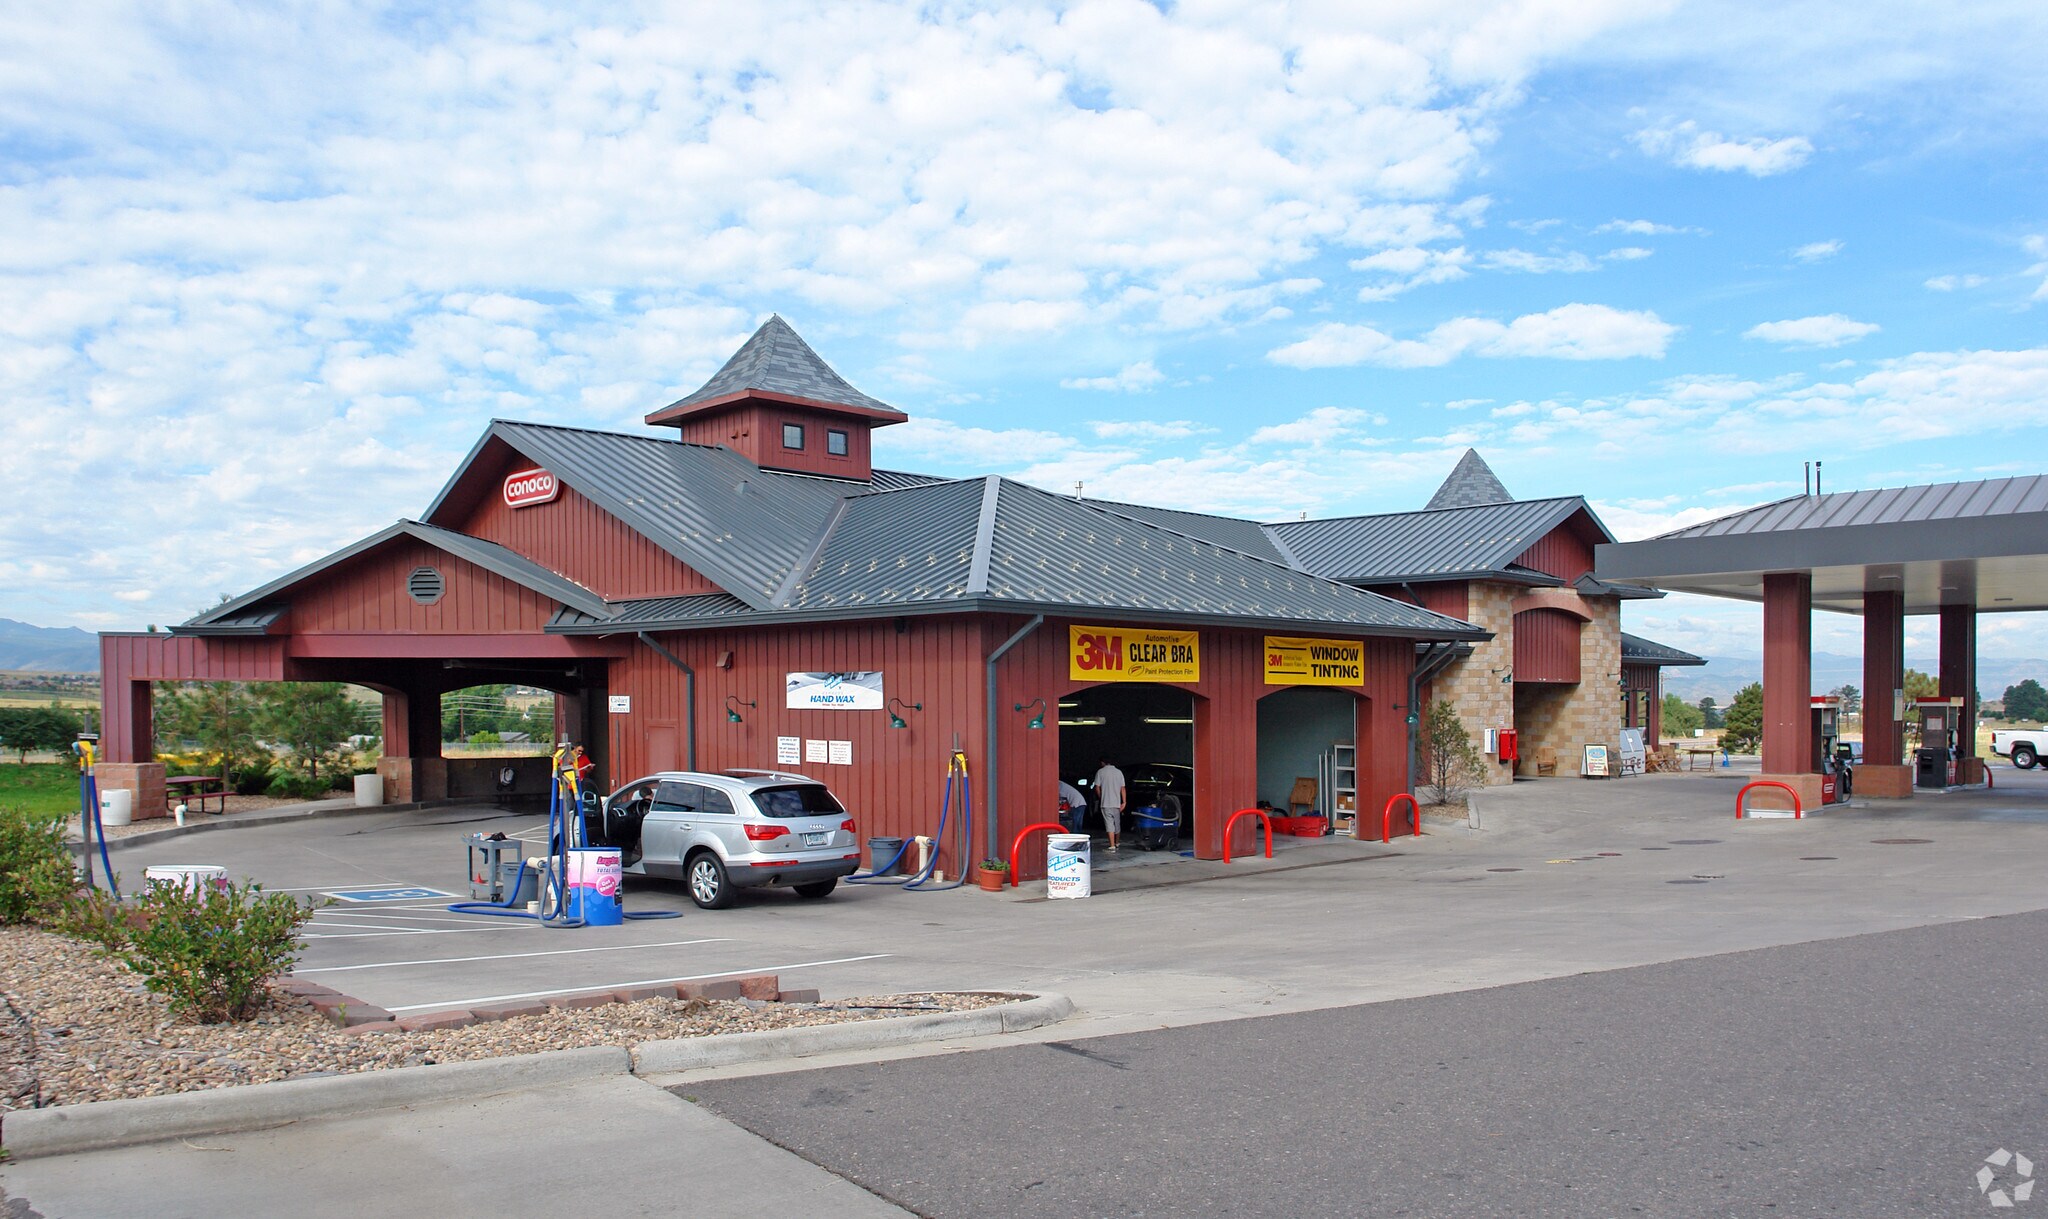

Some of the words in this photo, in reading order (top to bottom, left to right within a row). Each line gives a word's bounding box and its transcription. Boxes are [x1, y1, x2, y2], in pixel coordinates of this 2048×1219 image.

[1145, 634, 1180, 643] Automotive
[1076, 634, 1123, 671] 3M
[1129, 643, 1167, 663] CLEAR
[1171, 645, 1193, 663] BRA
[1310, 646, 1359, 661] WINDOW
[1268, 654, 1282, 667] 3M
[1311, 664, 1359, 678] TINTING
[810, 695, 834, 703] HAND
[835, 695, 855, 703] WAX
